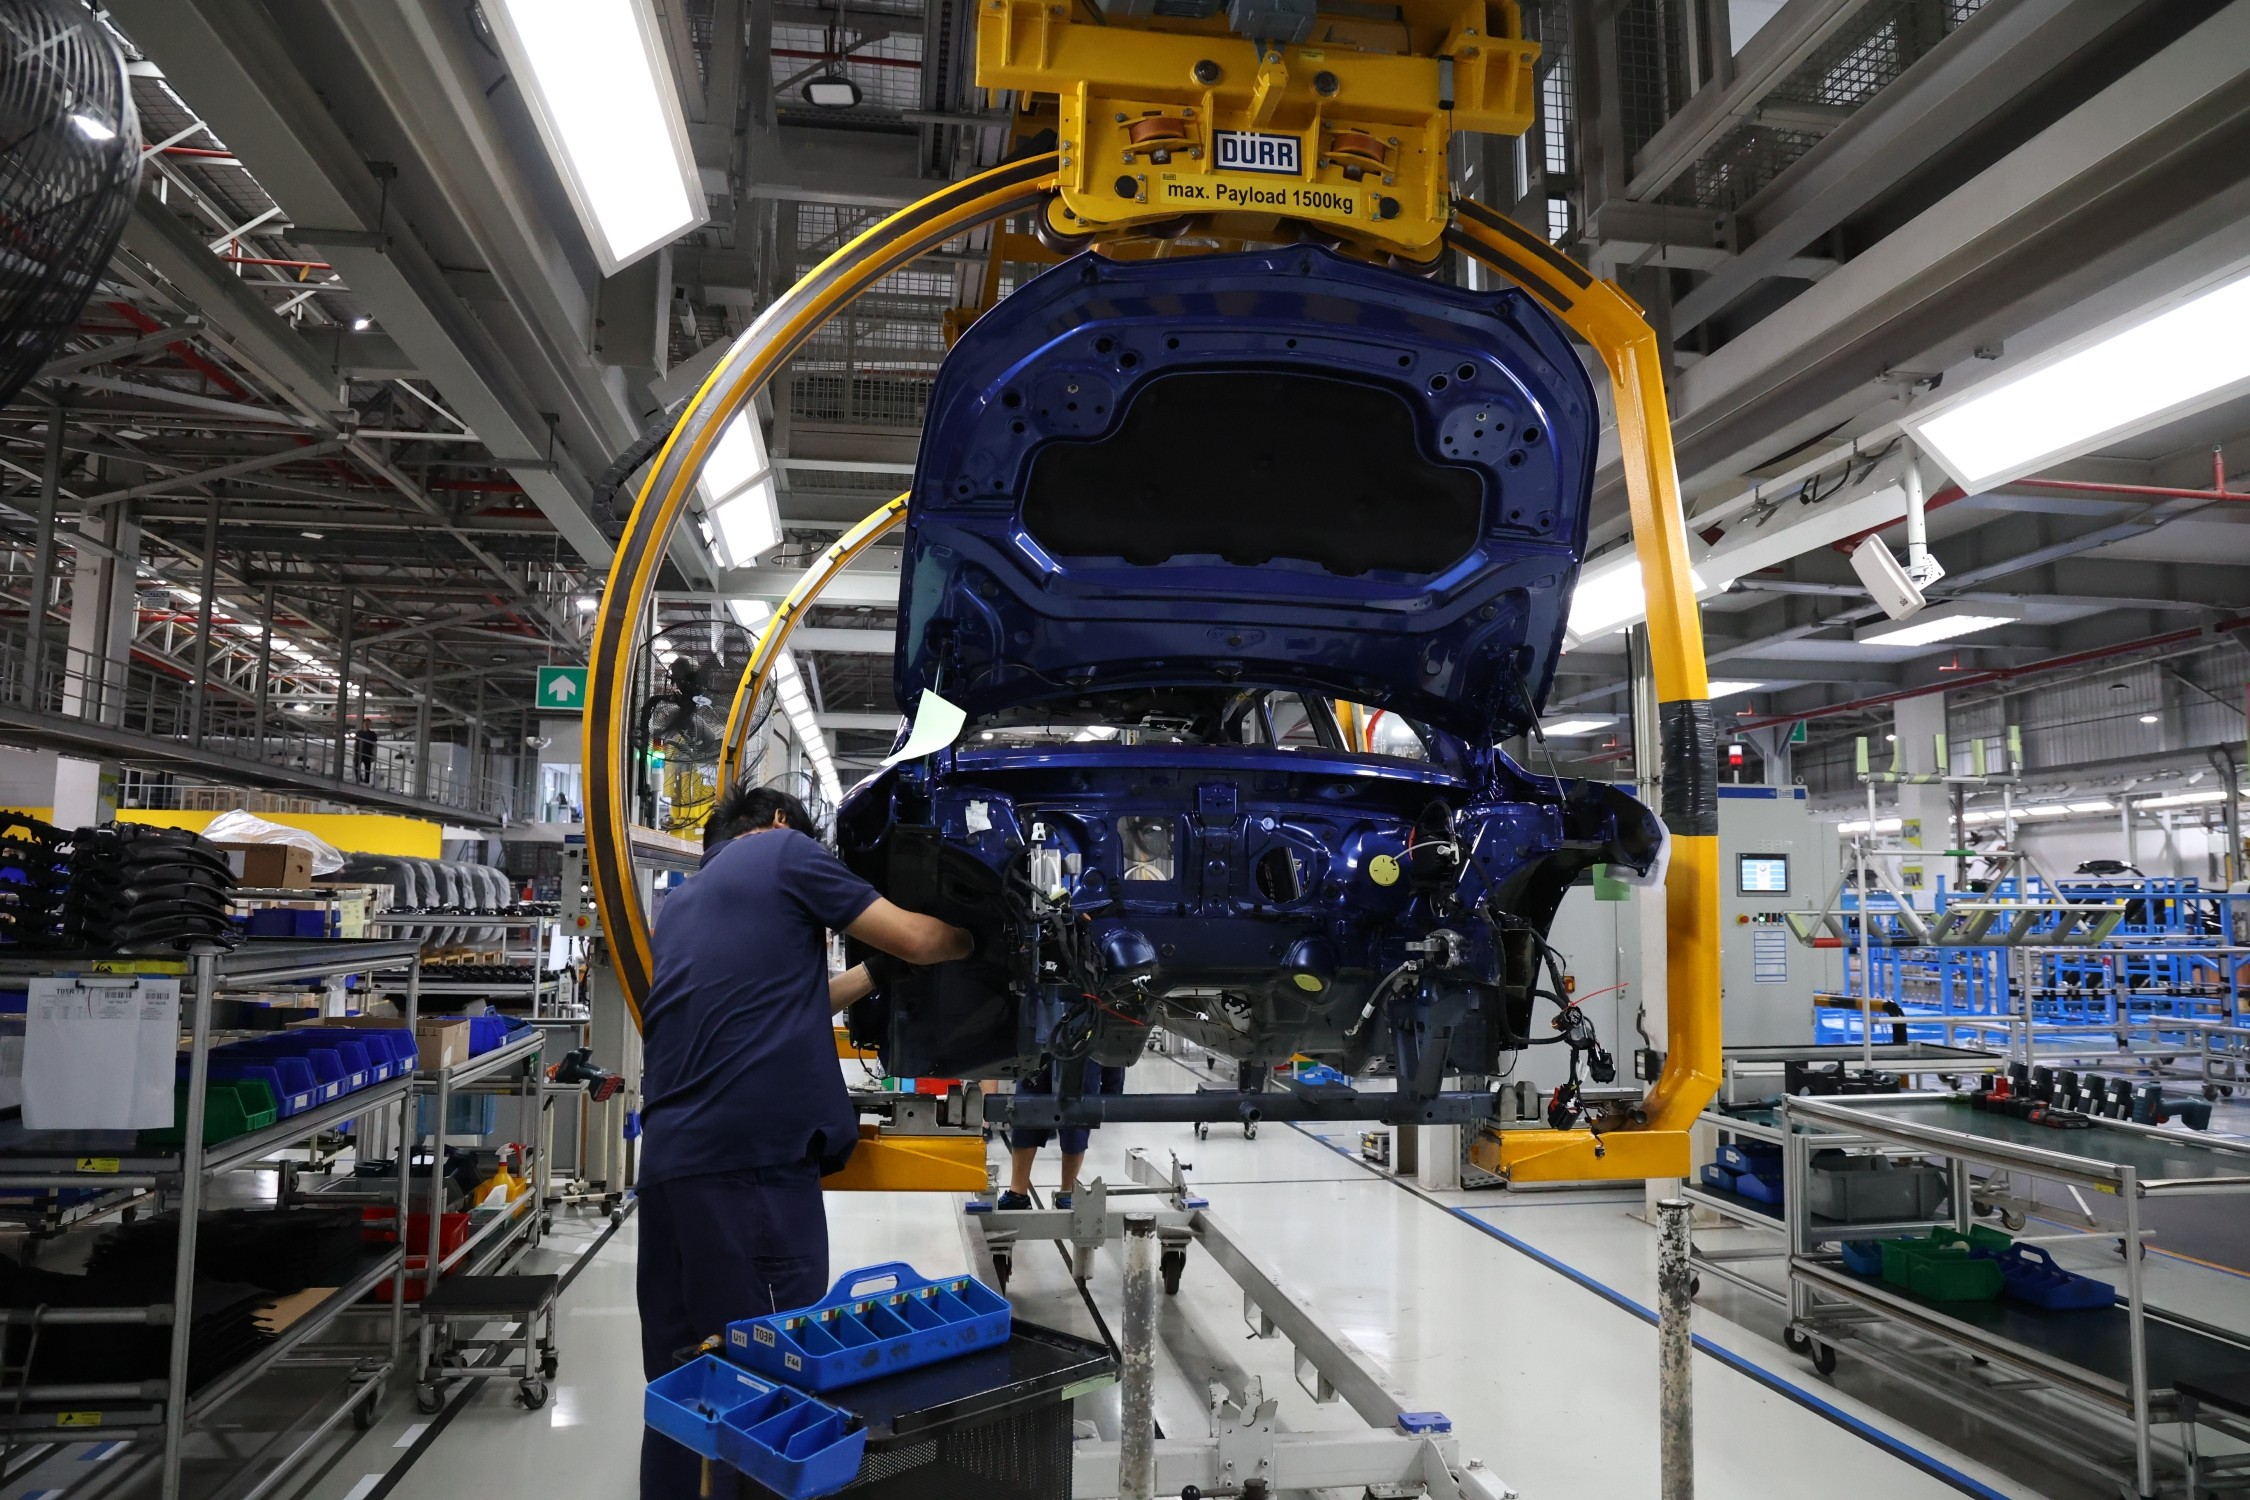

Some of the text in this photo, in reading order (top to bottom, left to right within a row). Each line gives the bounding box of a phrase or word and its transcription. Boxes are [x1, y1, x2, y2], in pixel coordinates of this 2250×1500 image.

[1222, 132, 1293, 167] DÜRR
[1168, 183, 1353, 214] max. Payload 1500kg
[733, 1332, 745, 1345] U11
[755, 1328, 774, 1344] T03R
[787, 1356, 799, 1368] F44
